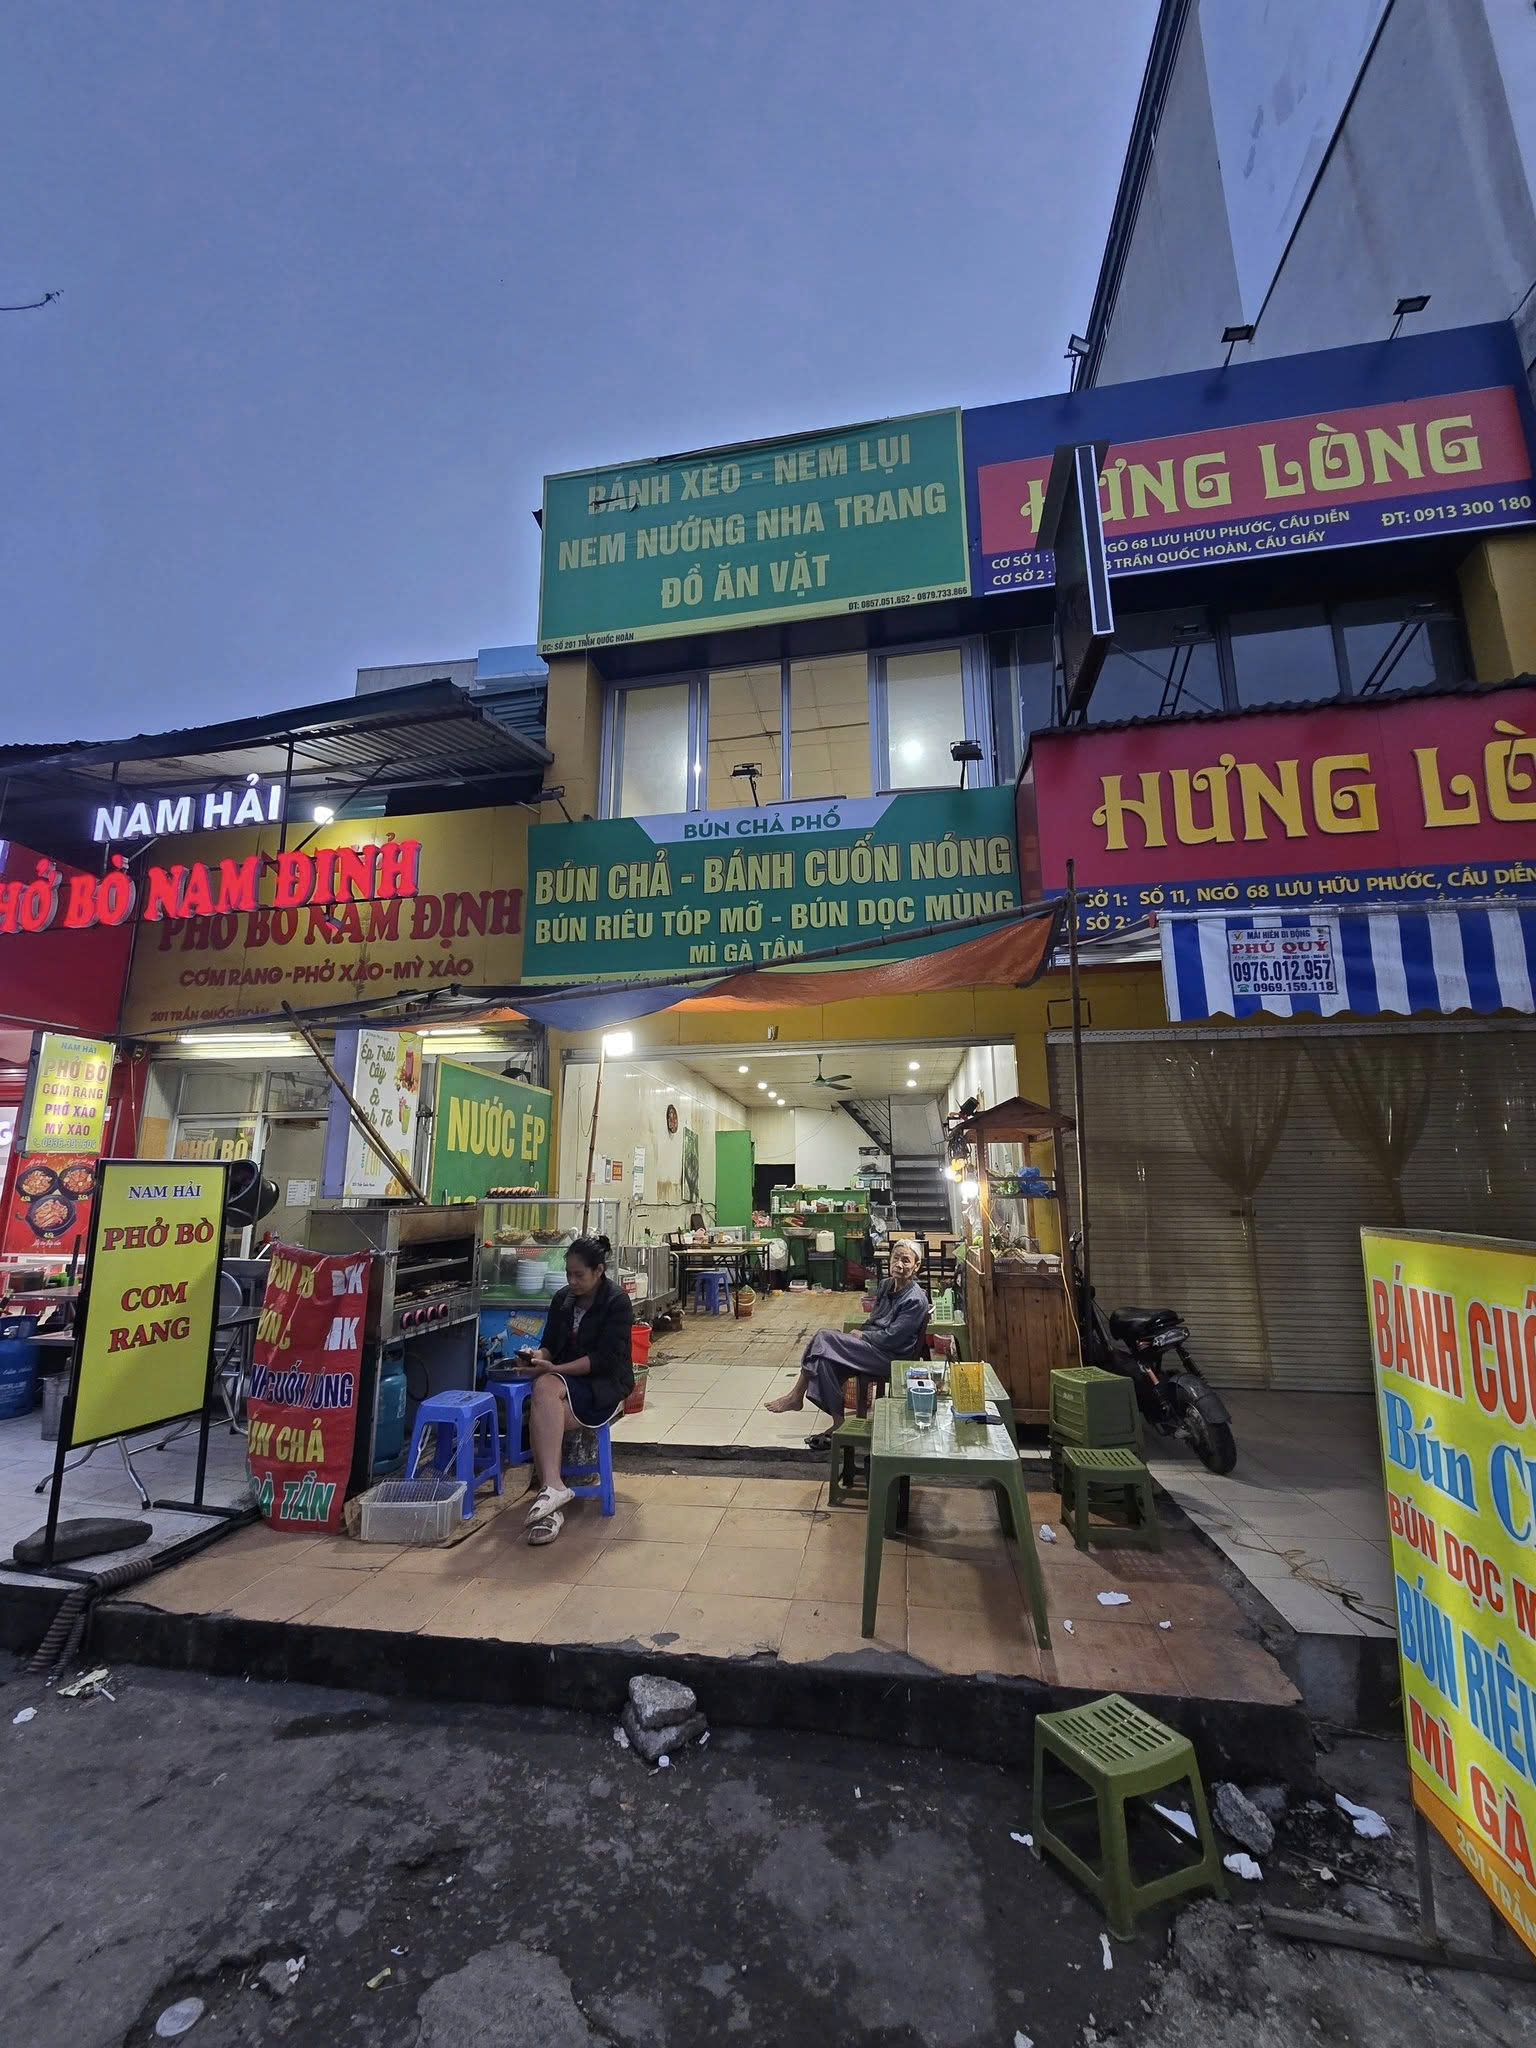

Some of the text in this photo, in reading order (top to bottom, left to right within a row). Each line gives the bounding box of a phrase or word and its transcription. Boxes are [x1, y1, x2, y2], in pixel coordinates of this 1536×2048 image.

[588, 469, 670, 515] BÁNH
[681, 457, 741, 501] XÈO
[774, 444, 847, 485] NEM
[860, 434, 911, 475] LỤI
[1258, 414, 1482, 500] LÒNG
[559, 482, 947, 571] NEM NƯỚNG NHA TRANG
[1104, 539, 1128, 554] GÕ
[1131, 539, 1148, 550] 68
[1151, 533, 1180, 547] LƯU
[1184, 529, 1215, 543] HỮU
[1220, 521, 1276, 538] PHƯỚC,
[1314, 509, 1350, 525] DIỄN
[1381, 495, 1532, 527] ĐT: 0913 300 180
[992, 556, 1010, 569] CƠ
[1013, 553, 1031, 566] SỞ
[1157, 547, 1201, 564] QUỐC
[1290, 531, 1326, 545] GIẤY
[661, 551, 830, 609] ĐỒ ĂN VẶT
[992, 572, 1011, 585] CƠ
[1014, 570, 1033, 583] SỞ
[565, 640, 576, 650] 201
[596, 634, 614, 646] QUỐC
[615, 632, 635, 643] HOÀN
[93, 773, 283, 842] NAM HẢI
[1092, 753, 1380, 850] HƯNG
[683, 806, 841, 839] BÚN CHẢ PHỐ
[144, 856, 262, 921] NAM
[534, 855, 598, 905] BÚN
[607, 850, 673, 899] CHẢ
[703, 850, 793, 894] BÁNH
[804, 833, 901, 887] CUỐN
[911, 833, 1014, 880] NÓNG
[1139, 885, 1164, 905] SỐ
[1197, 882, 1238, 902] NGÕ
[1247, 885, 1269, 899] 68
[1275, 879, 1312, 897] LƯU
[1318, 876, 1360, 894] HỮU
[1367, 871, 1442, 892] PHƯỚC,
[1447, 867, 1488, 886] CẦU
[409, 889, 523, 949] ĐỊNH
[534, 910, 587, 944] BÚN
[594, 907, 660, 940] RIÊU
[662, 901, 709, 935] TÓP
[720, 900, 764, 933] MỠ
[791, 897, 848, 930] BÚN
[858, 898, 915, 934] DỌC
[925, 888, 1014, 922] MÙNG
[1085, 912, 1111, 930] SỞ
[689, 935, 804, 964] MÌ GÀ TẦN
[1231, 940, 1275, 954] PHÚ
[1233, 960, 1331, 982] 0976.012.957
[1253, 981, 1334, 992] 0969.159.118
[43, 1083, 103, 1100] CƠM RANG
[369, 1062, 386, 1084] Cây
[45, 1101, 96, 1118] PHỞ XÀO
[67, 1122, 90, 1136] XÀO
[447, 1094, 545, 1161] NƯỚC ÉP
[129, 1181, 202, 1199] NAM HẢI
[102, 1217, 214, 1251] PHỞ BÒ
[120, 1281, 188, 1312] CƠM
[108, 1317, 191, 1354] RANG
[1372, 1265, 1463, 1398] BÁNH
[276, 1418, 325, 1462] CHẢ
[1382, 1389, 1478, 1512] Bún
[280, 1471, 336, 1522] TẦN
[1388, 1491, 1438, 1564] BÚN
[1443, 1530, 1503, 1612] DỌC
[1397, 1575, 1459, 1708] BÚN
[1409, 1694, 1536, 1890] MÌ GÀ
[1457, 1827, 1487, 1880] 201
